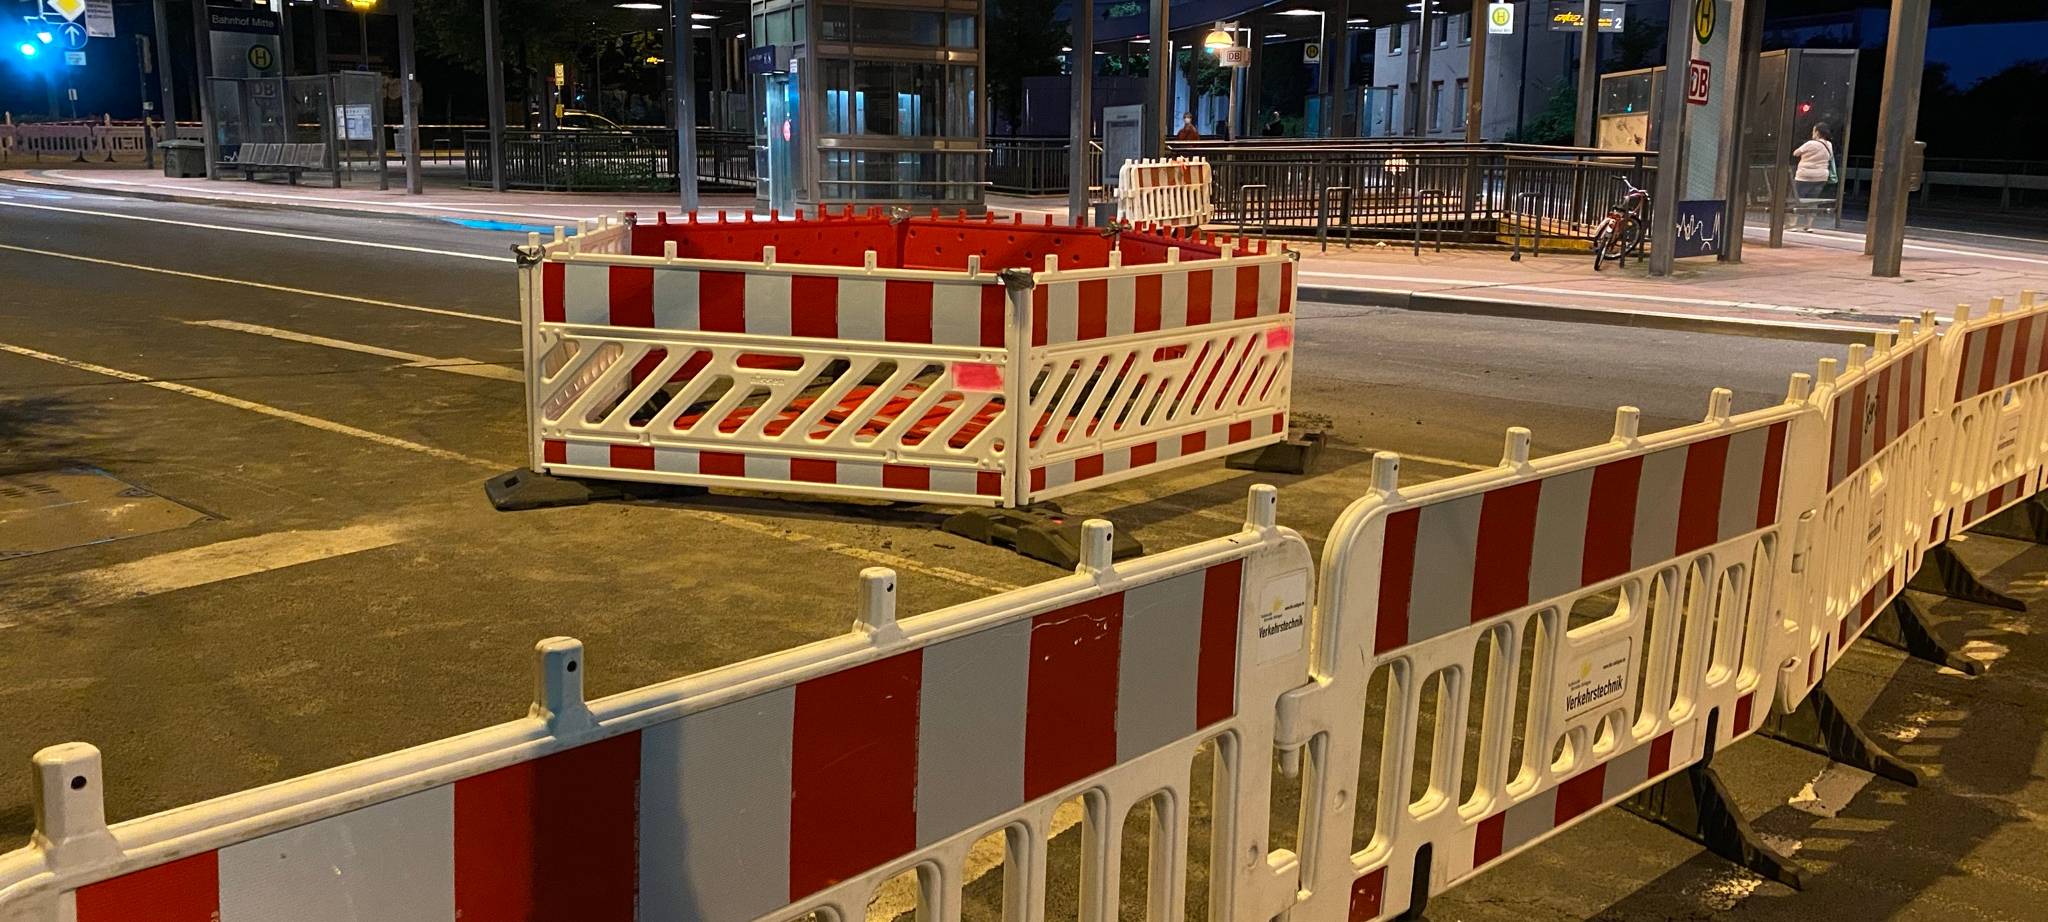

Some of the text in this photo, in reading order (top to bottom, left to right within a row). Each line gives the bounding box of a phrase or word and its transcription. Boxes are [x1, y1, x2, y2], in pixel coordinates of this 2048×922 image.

[211, 14, 275, 28] Bahnhof Mitte
[1614, 17, 1622, 29] 2
[254, 49, 267, 66] H
[1228, 52, 1241, 61] DB
[1689, 66, 1709, 98] DB
[1258, 614, 1304, 639] Verkehrstechnik
[1566, 674, 1624, 713] Verkehrstechnik
